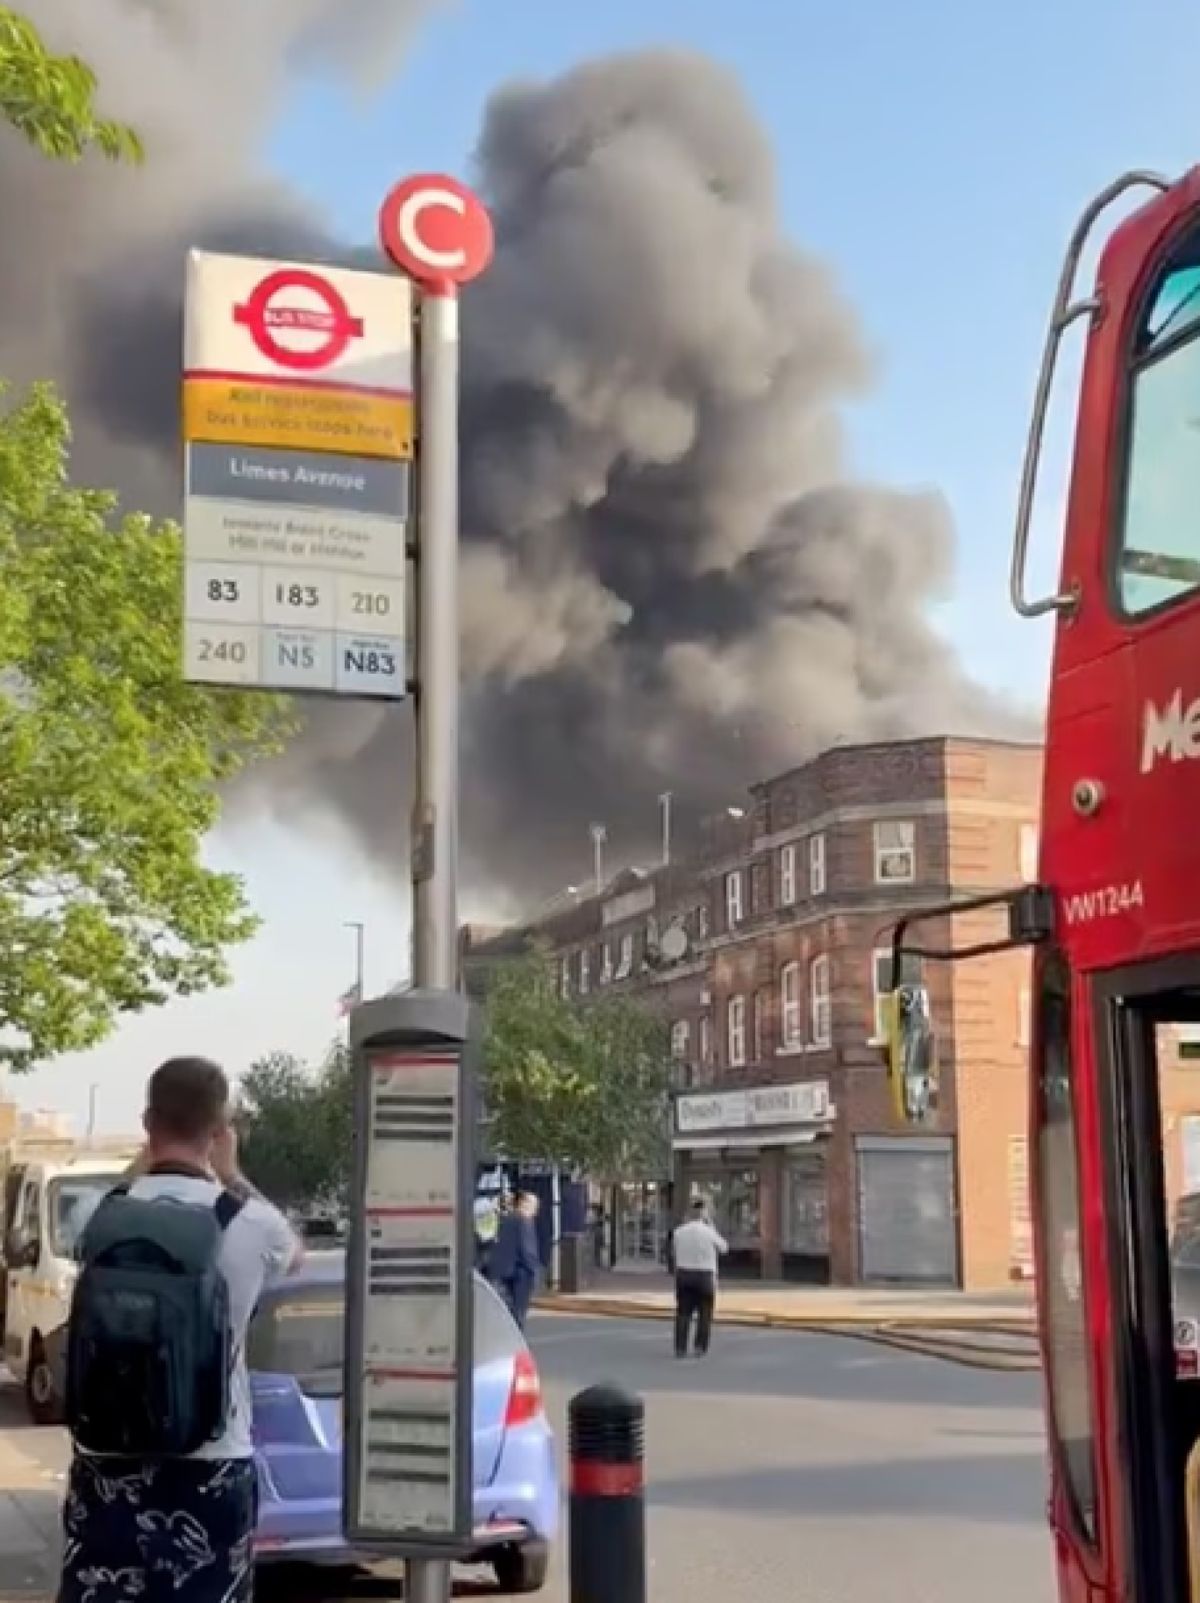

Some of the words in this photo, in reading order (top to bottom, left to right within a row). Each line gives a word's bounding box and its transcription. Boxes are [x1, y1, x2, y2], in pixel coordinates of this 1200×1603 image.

[399, 189, 466, 269] C
[230, 456, 290, 483] Limes
[207, 578, 240, 602] 83
[276, 583, 320, 607] 183
[351, 591, 391, 616] 210
[197, 639, 247, 664] 240
[278, 643, 315, 669] N5
[344, 650, 396, 675] N83
